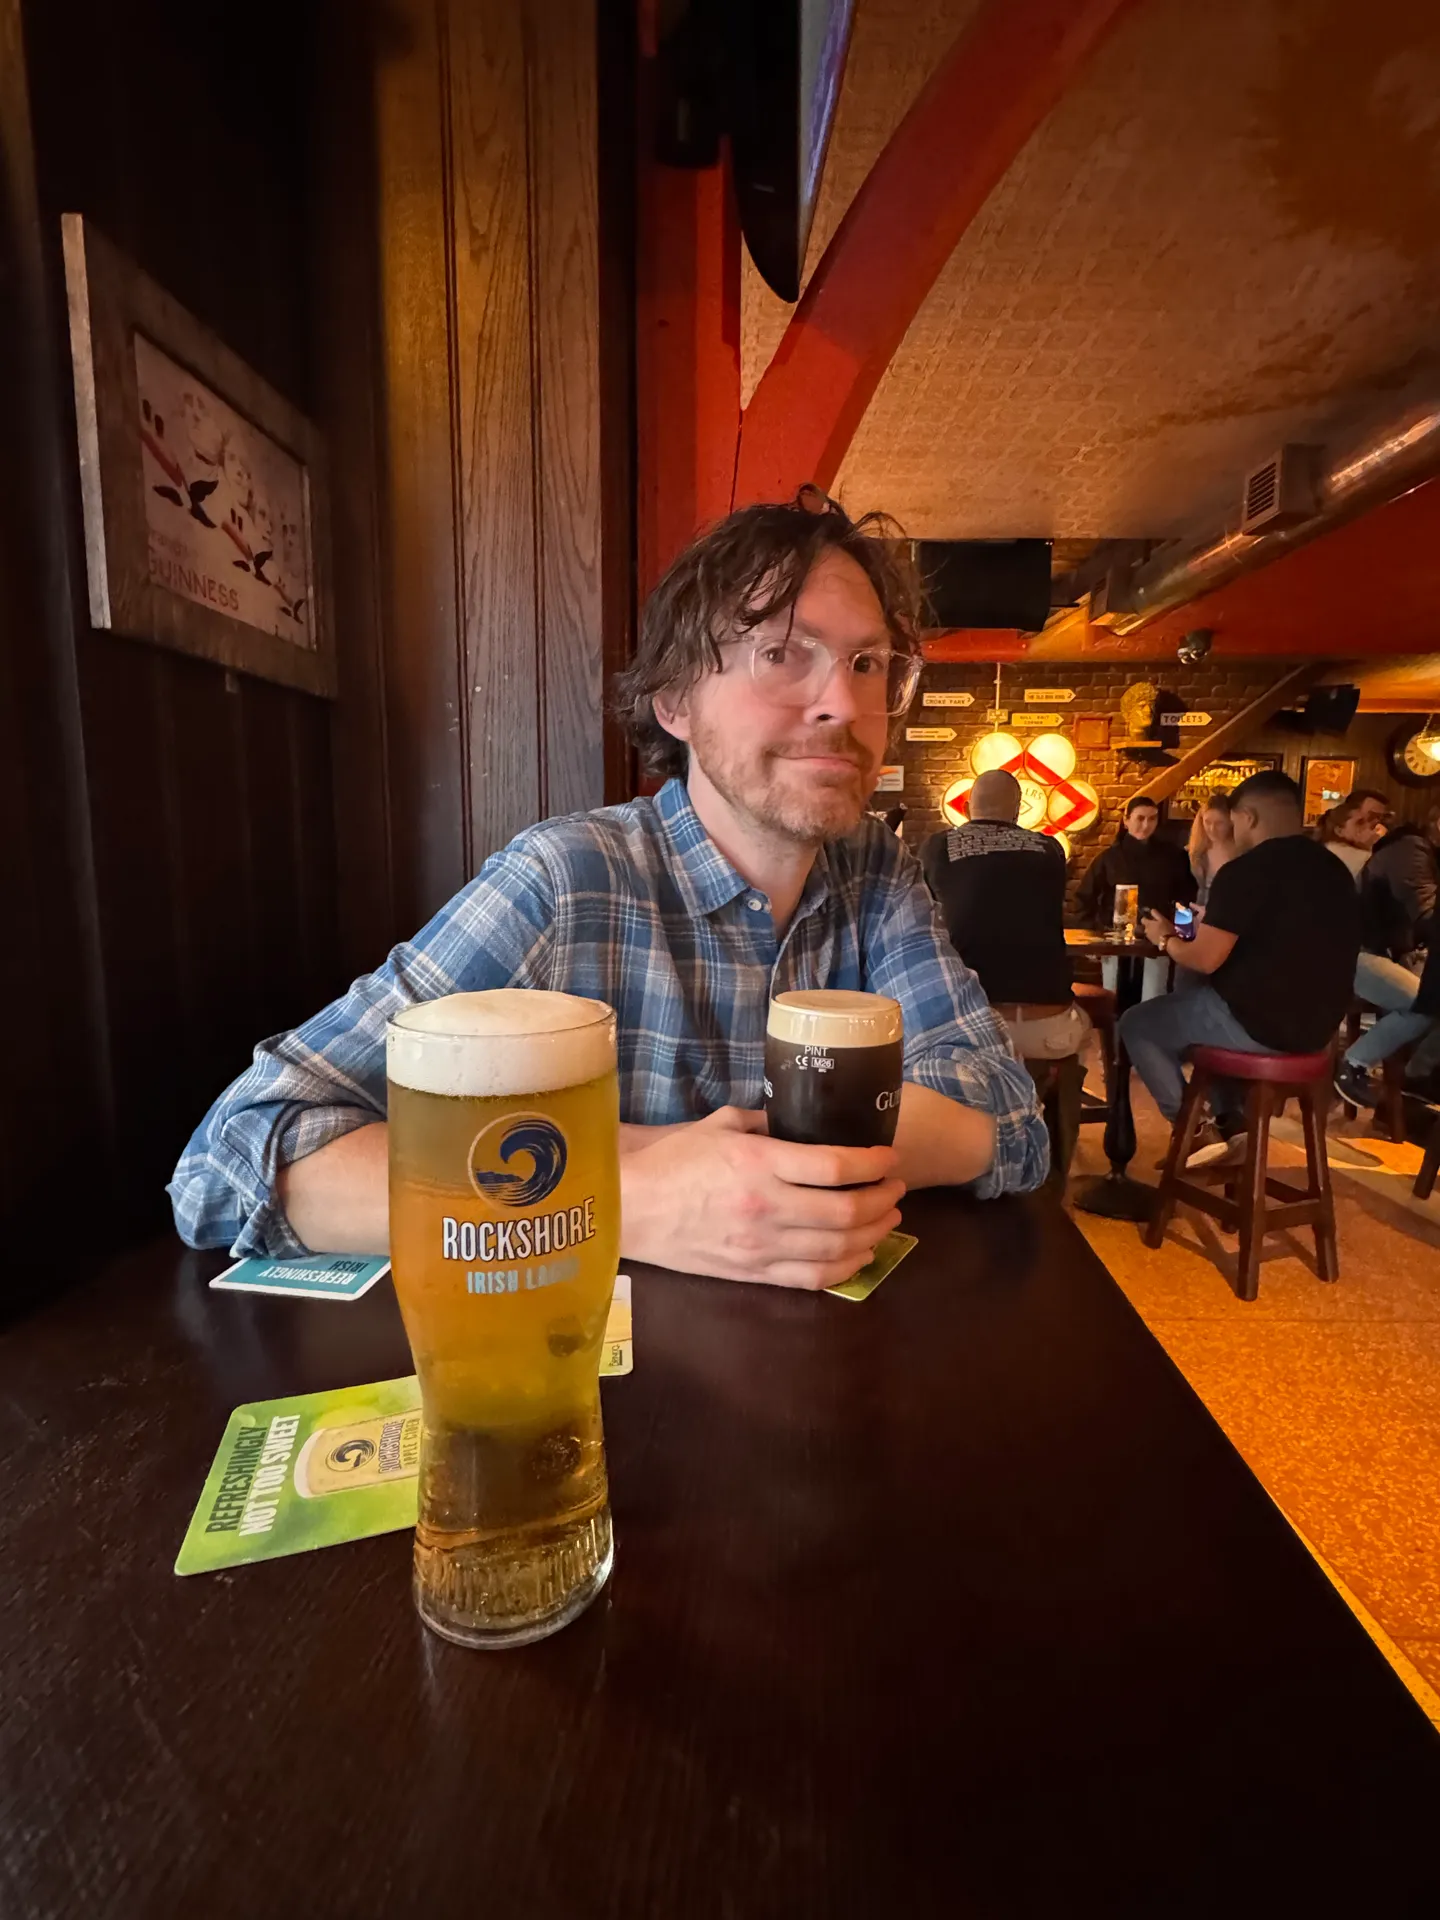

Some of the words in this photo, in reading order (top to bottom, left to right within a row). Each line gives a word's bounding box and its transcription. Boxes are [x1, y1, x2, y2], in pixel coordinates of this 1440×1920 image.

[1164, 715, 1203, 723] TOILETS
[804, 1045, 829, 1057] PINT
[442, 1195, 596, 1263] ROCKSHORE
[257, 1265, 358, 1286] REFRESHINGLY
[328, 1260, 370, 1273] IRISH
[467, 1270, 519, 1295] IRISH
[260, 1414, 301, 1465] SWEET
[403, 1418, 421, 1440] CIDER
[378, 1418, 406, 1474] ROCKSHORE
[403, 1442, 418, 1466] APPLE
[205, 1426, 269, 1533] REFRESHINGLY
[250, 1463, 289, 1501] TOO
[239, 1499, 280, 1536] NOT
